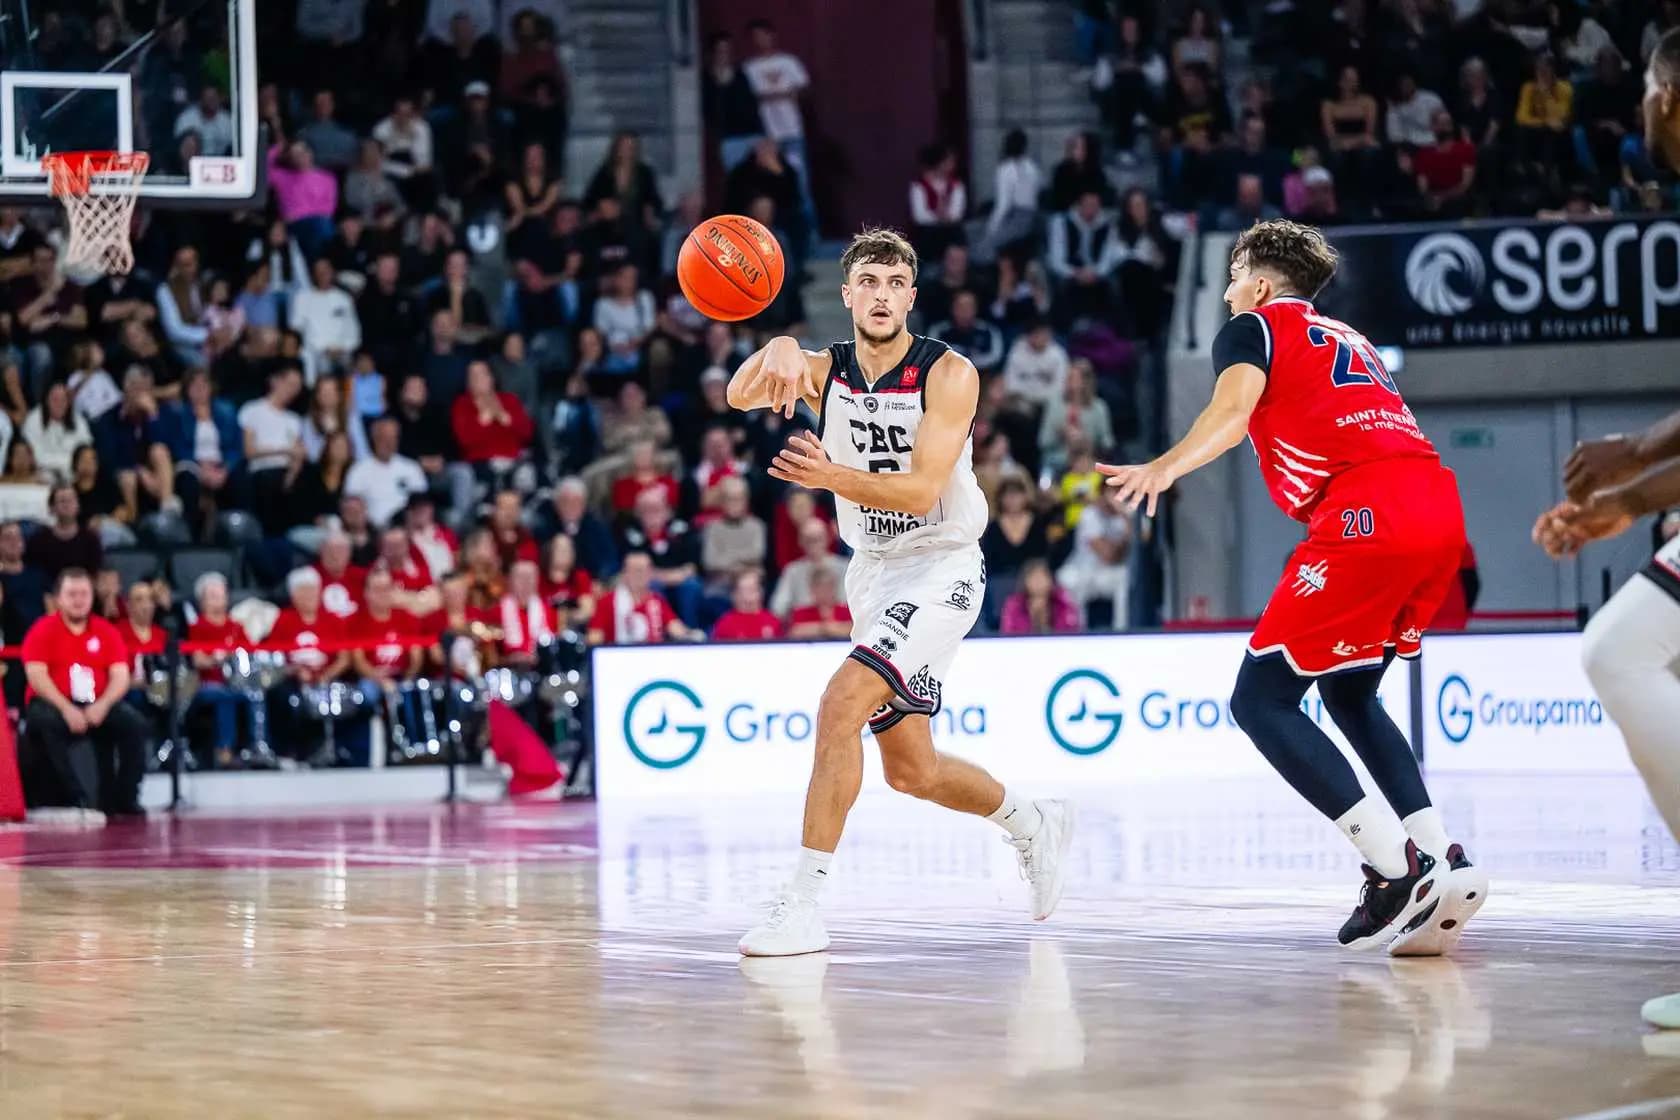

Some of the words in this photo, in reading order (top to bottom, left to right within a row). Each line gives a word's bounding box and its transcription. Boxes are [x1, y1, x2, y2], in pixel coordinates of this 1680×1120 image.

[1307, 323, 1399, 395] 20
[849, 419, 913, 454] CBC
[868, 515, 920, 536] IMMO
[1341, 507, 1375, 539] 20
[1479, 692, 1602, 734] Groupama
